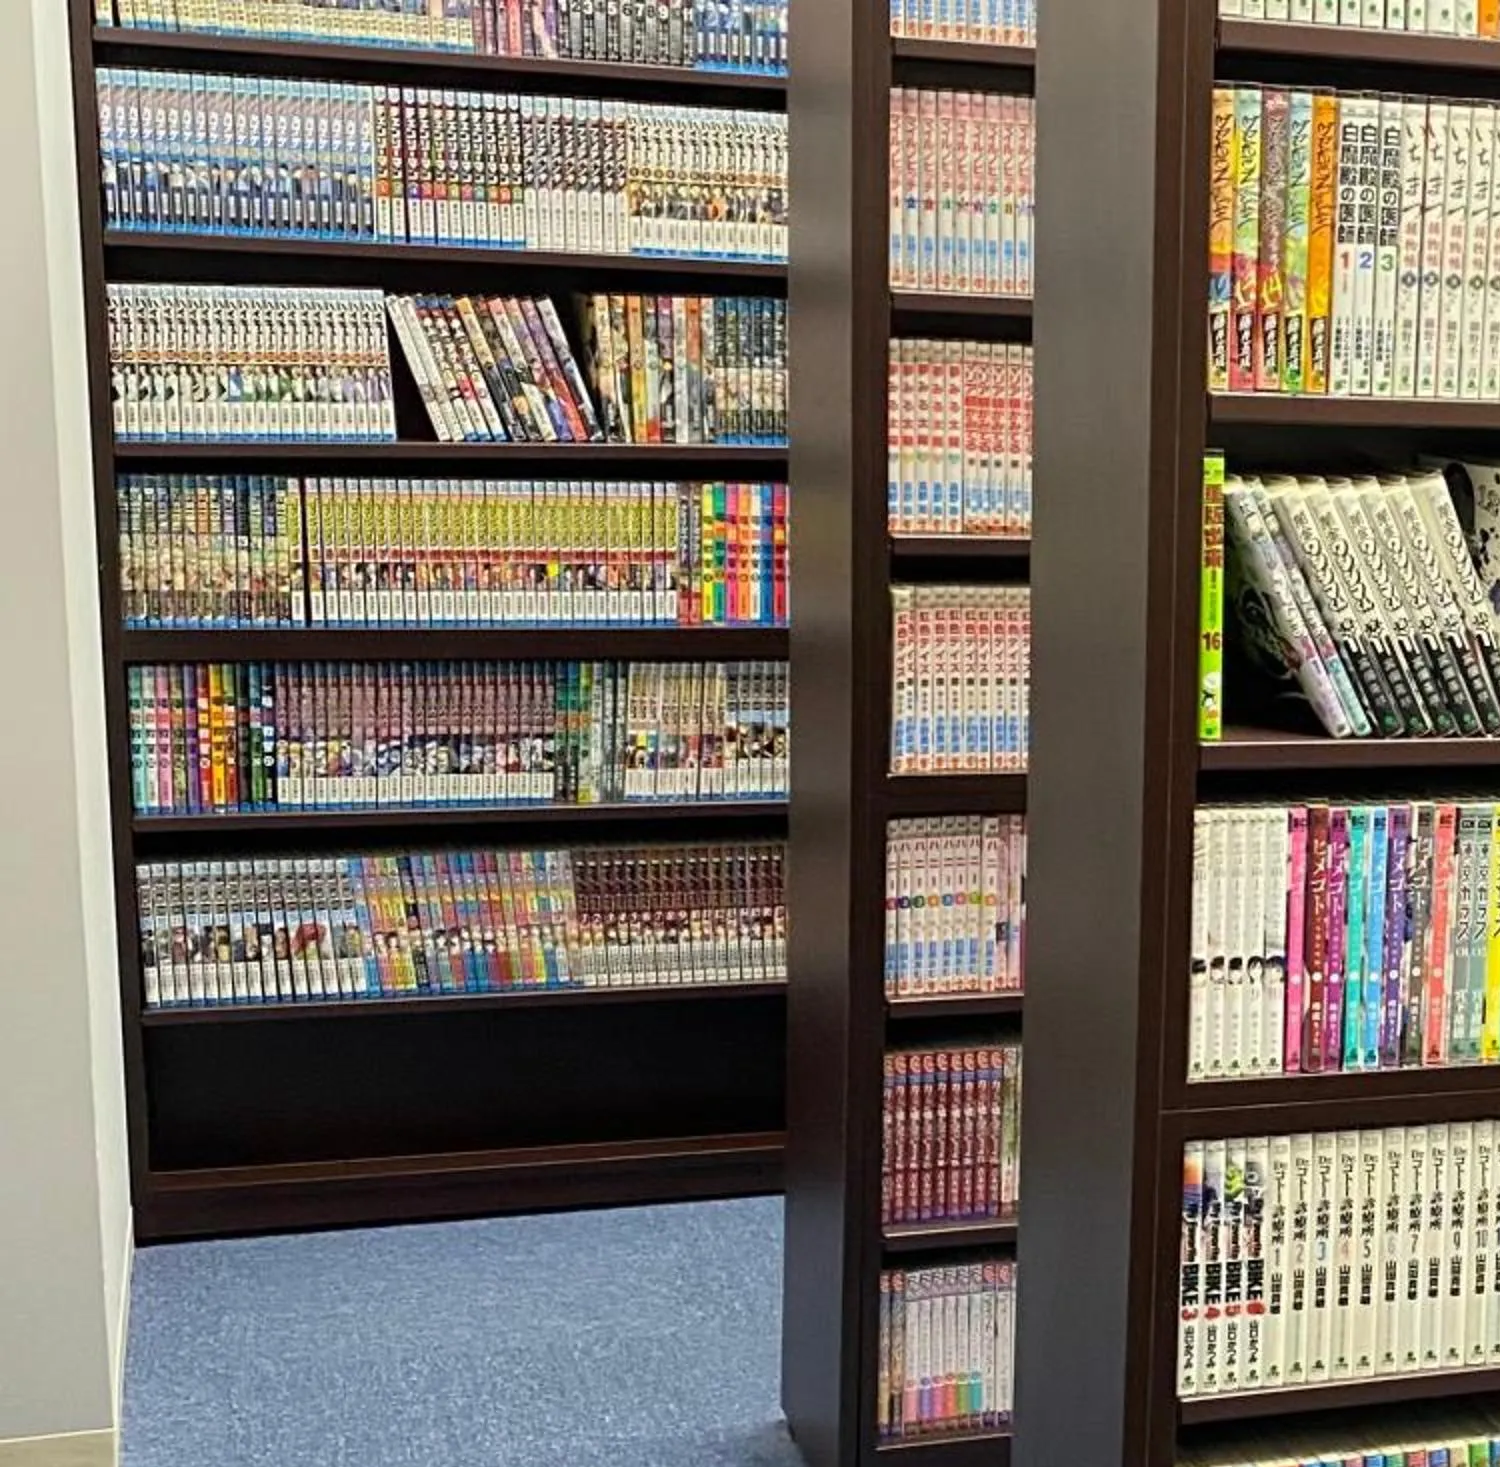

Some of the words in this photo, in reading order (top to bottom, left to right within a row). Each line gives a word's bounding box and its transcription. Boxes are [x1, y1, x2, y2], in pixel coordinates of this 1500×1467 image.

[1341, 252, 1350, 269] 1
[1359, 251, 1371, 269] 2
[1380, 255, 1394, 272] 3
[1202, 633, 1221, 651] 16
[1453, 1232, 1460, 1250] 9
[1476, 1228, 1488, 1248] 10
[1317, 1242, 1327, 1261] 3
[1362, 1240, 1371, 1258] 5
